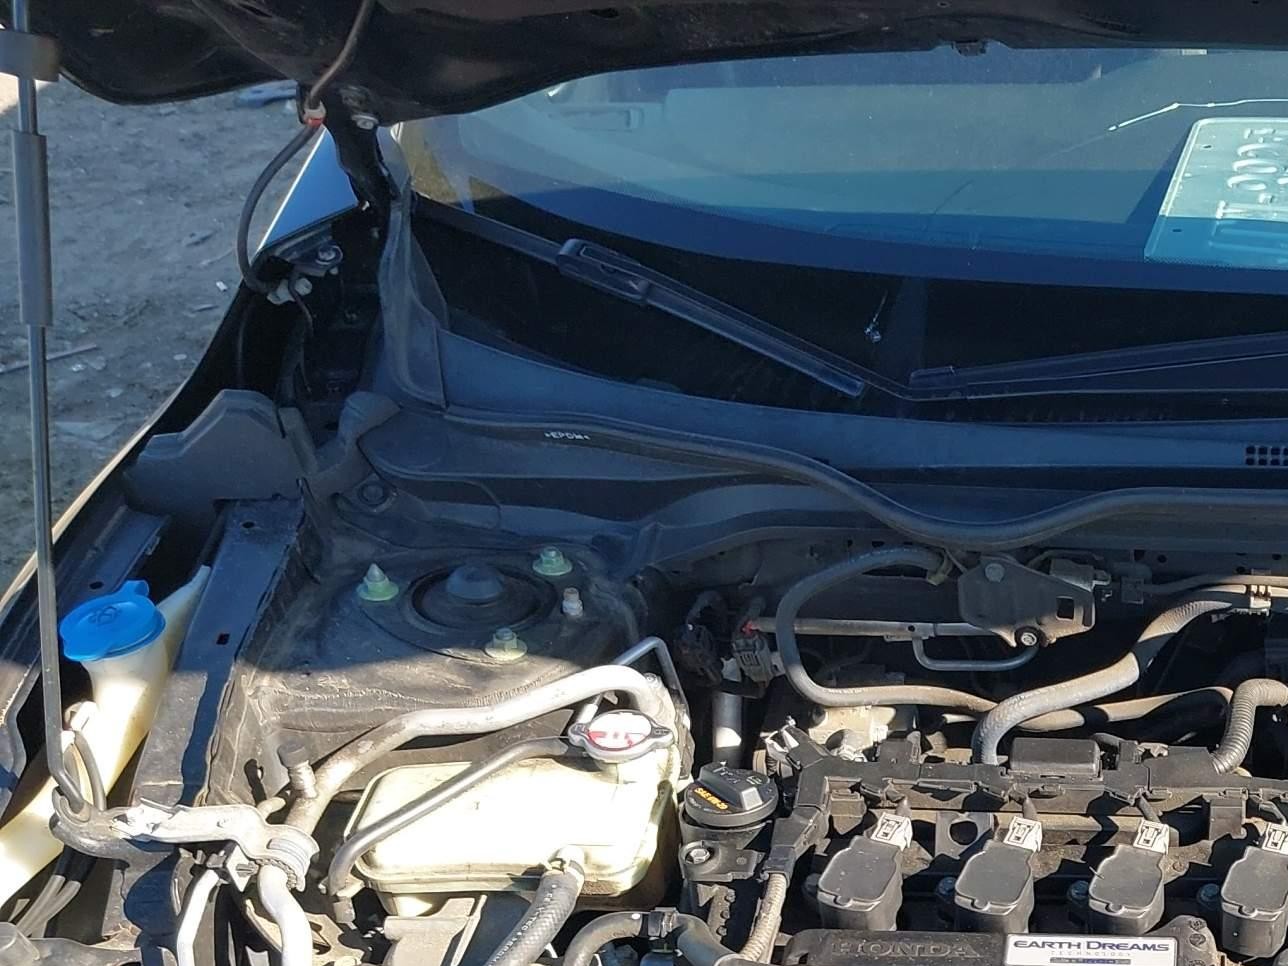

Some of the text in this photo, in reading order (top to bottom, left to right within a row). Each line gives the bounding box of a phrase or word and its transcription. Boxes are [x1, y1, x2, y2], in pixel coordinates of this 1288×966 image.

[830, 941, 983, 958] HONDA
[1013, 940, 1170, 951] EARTH DREAMS
